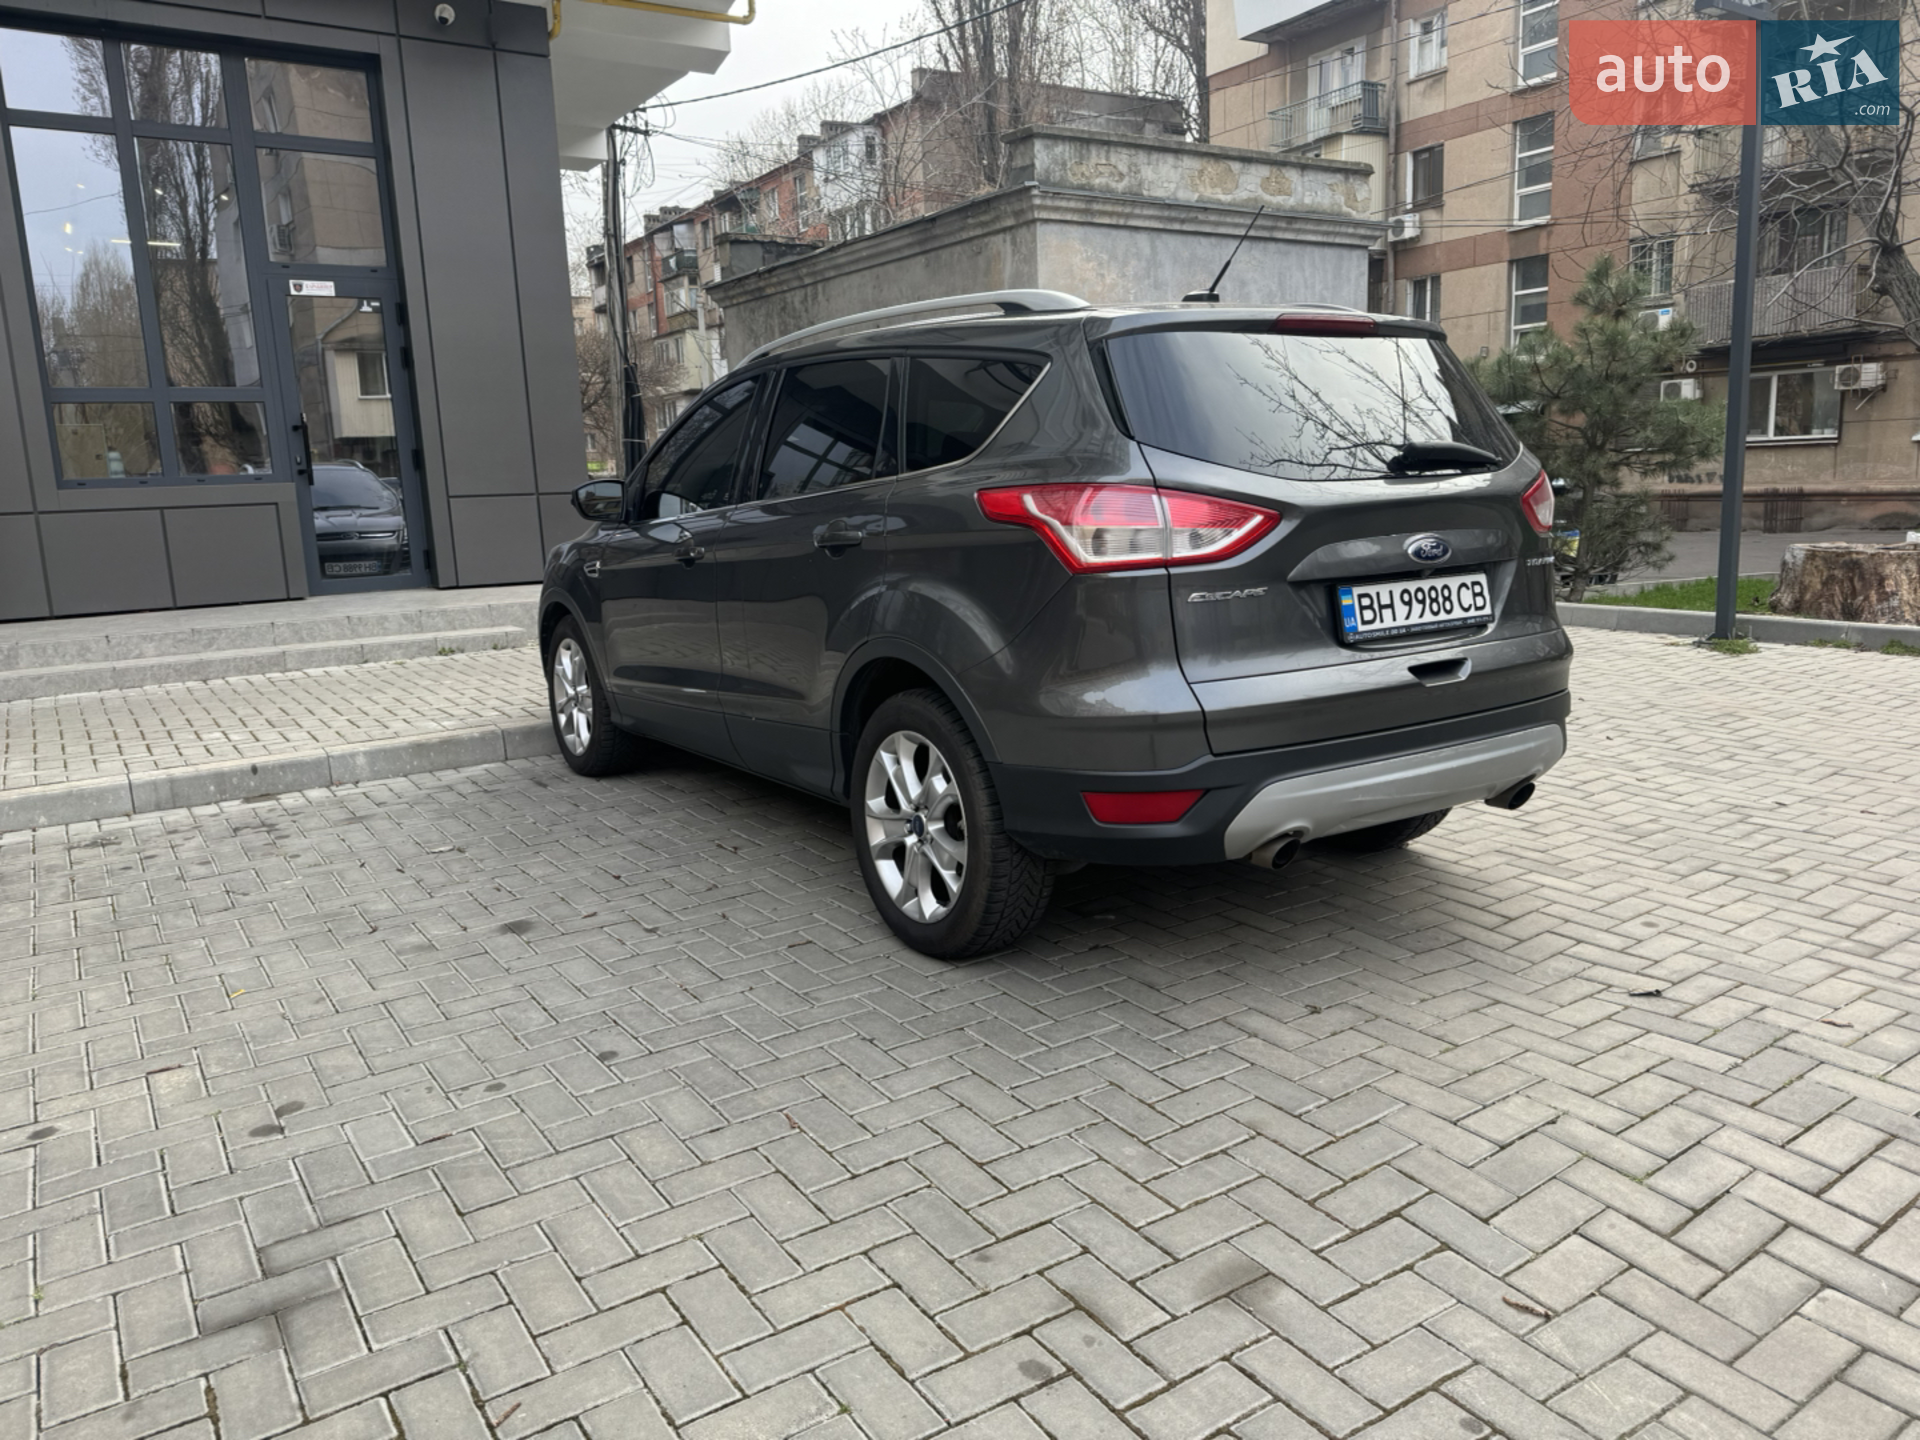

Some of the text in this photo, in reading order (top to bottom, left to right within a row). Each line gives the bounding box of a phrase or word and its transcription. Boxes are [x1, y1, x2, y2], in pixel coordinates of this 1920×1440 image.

[1420, 541, 1444, 558] Ford
[1357, 580, 1487, 626] BH 9988 CB
[1344, 617, 1357, 628] UA
